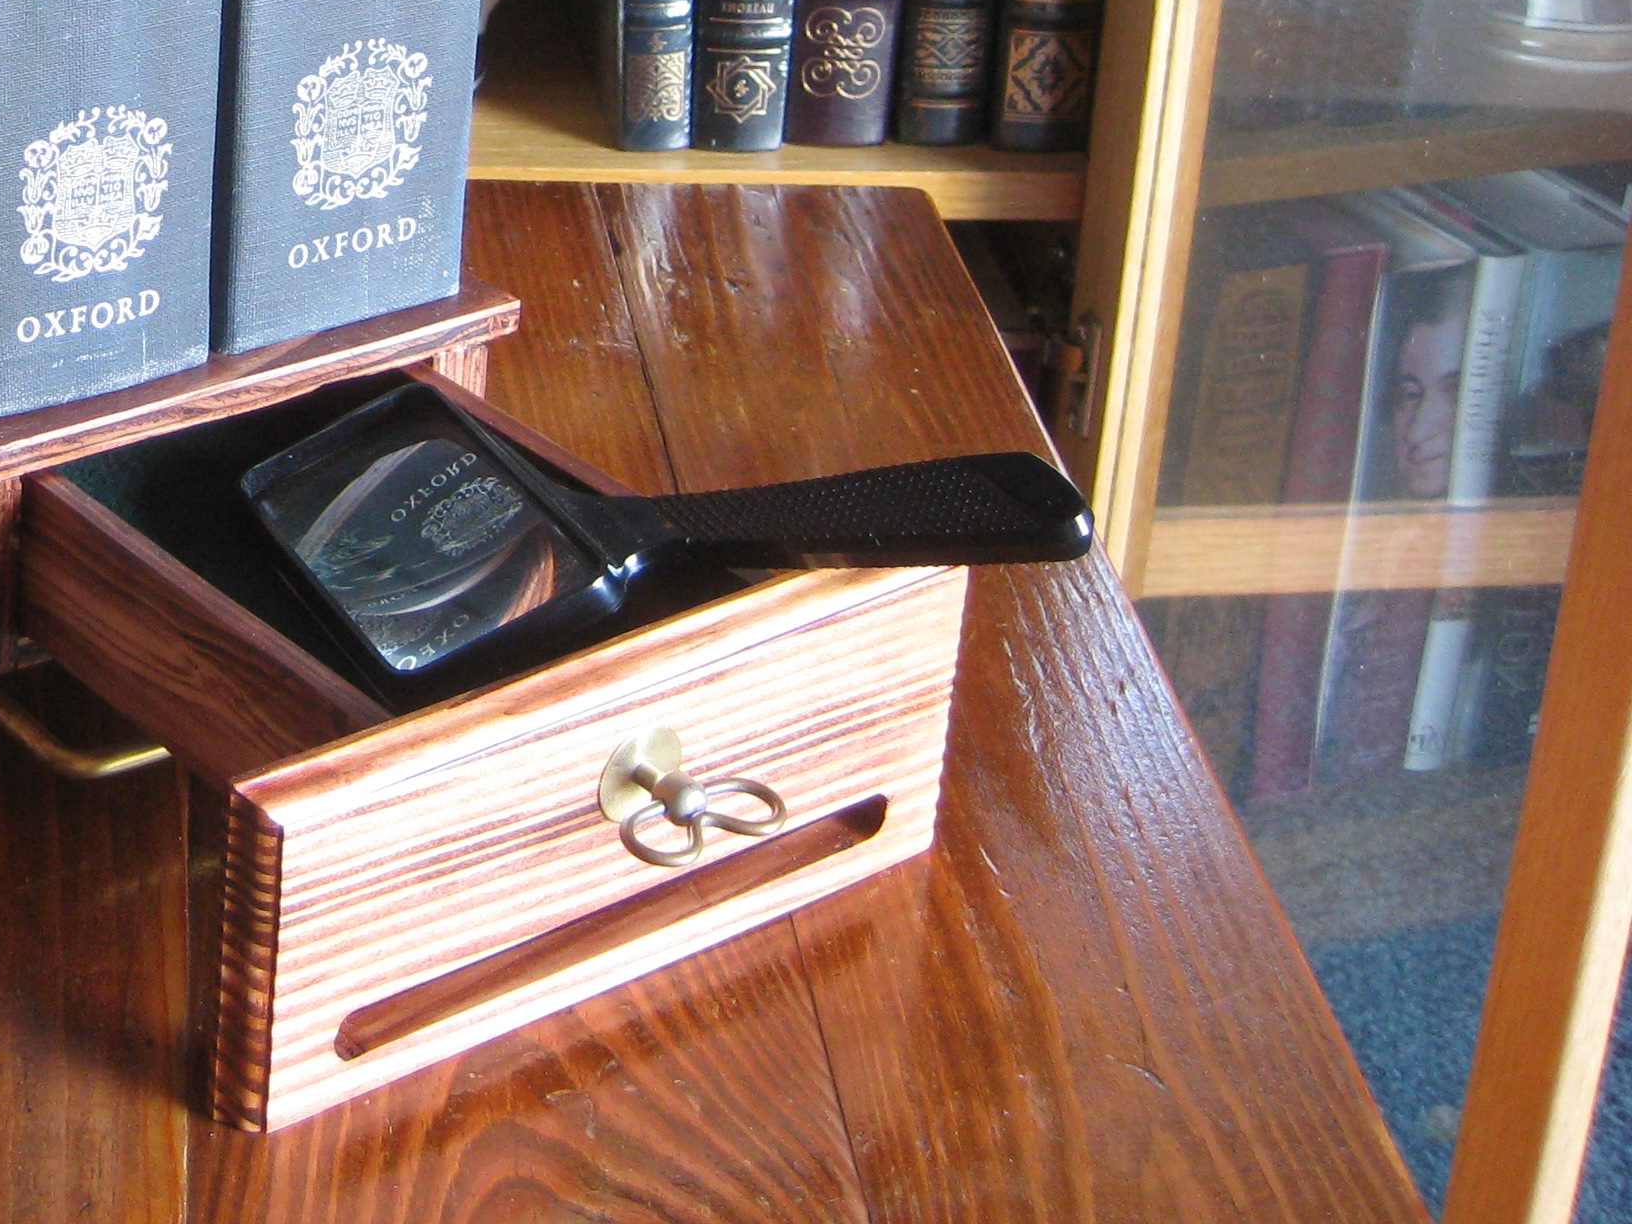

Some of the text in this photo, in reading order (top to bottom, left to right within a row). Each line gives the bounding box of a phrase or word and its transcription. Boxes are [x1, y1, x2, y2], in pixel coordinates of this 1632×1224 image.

[721, 2, 776, 14] THOREAU
[287, 215, 418, 270] OXFORD
[15, 288, 161, 344] OXFORD
